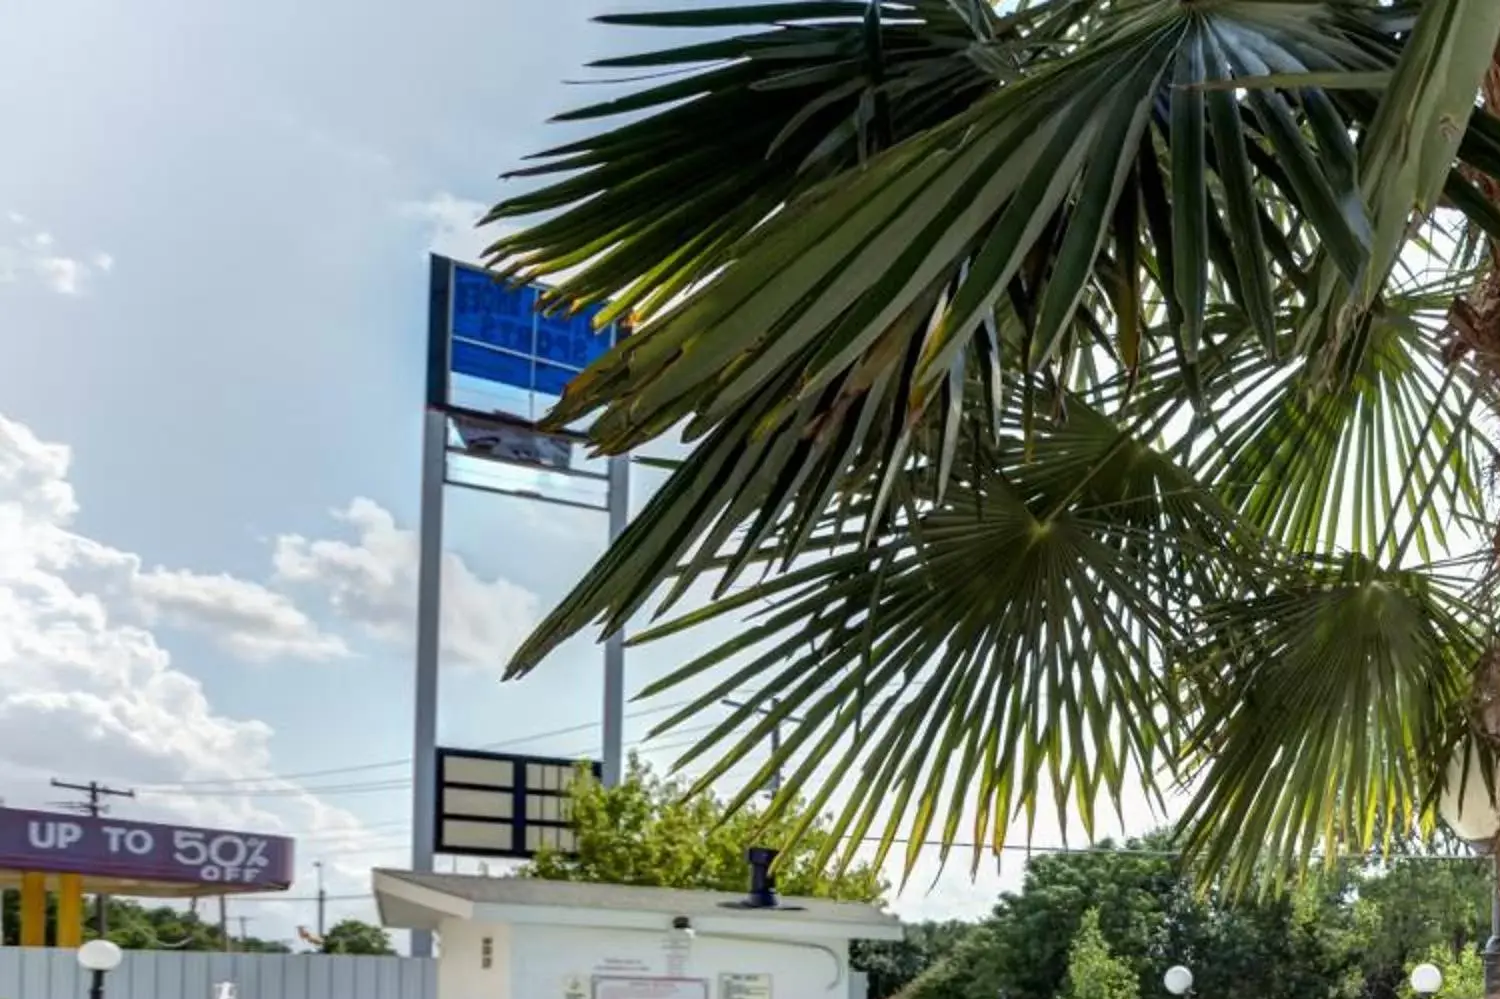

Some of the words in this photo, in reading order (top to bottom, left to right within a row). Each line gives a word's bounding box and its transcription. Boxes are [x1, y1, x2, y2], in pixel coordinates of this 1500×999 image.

[29, 821, 82, 849] UP
[103, 827, 153, 854] TO
[173, 832, 269, 867] 50%
[201, 867, 261, 882] OFF
